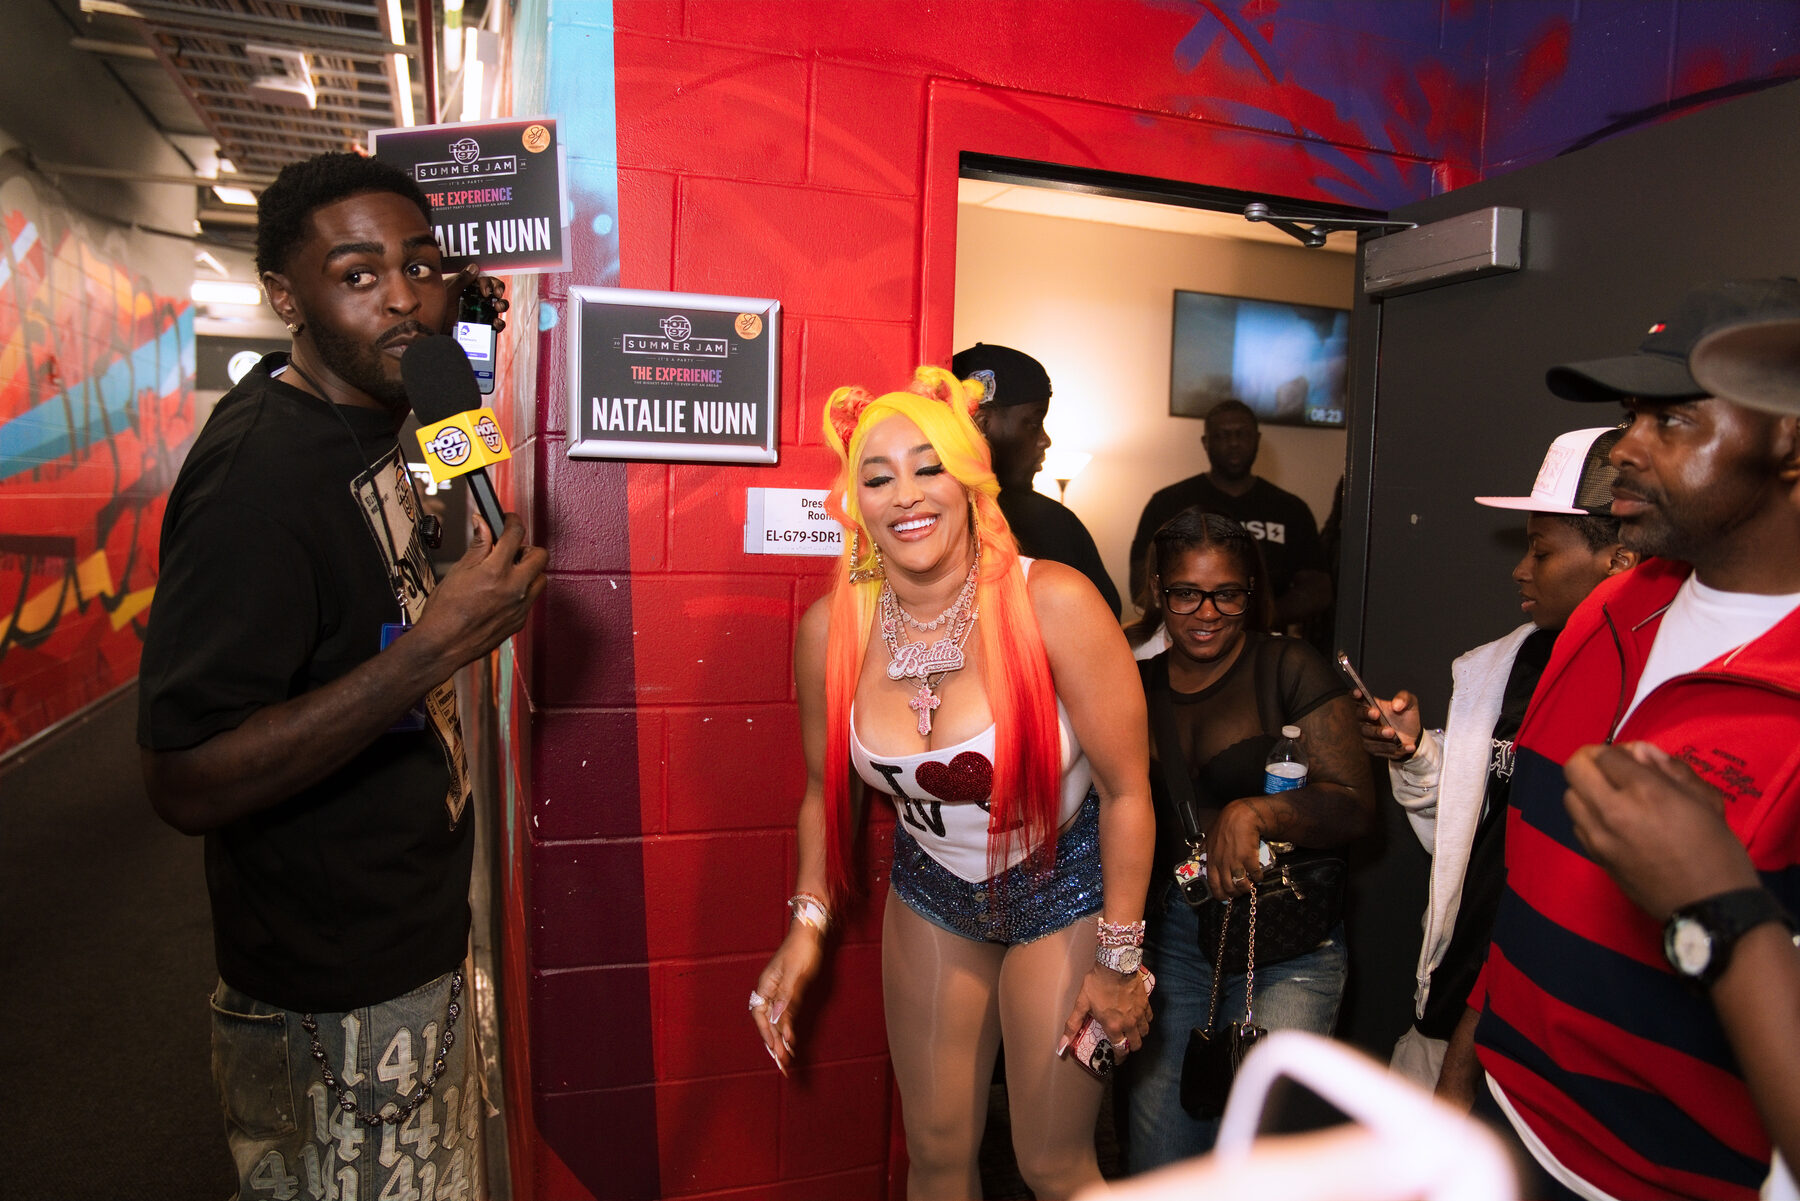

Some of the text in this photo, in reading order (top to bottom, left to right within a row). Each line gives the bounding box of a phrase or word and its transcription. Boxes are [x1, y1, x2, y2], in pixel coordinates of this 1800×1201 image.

[420, 161, 512, 177] SUMMER JAM
[424, 187, 513, 207] THE EXPERIENCE
[430, 217, 551, 258] ALIE NUNN
[628, 340, 723, 353] SUMMER JAM
[631, 366, 723, 384] THE EXPERIENCE
[592, 396, 757, 435] NATALIE NUNN
[486, 433, 501, 447] 97
[442, 442, 466, 460] 97
[801, 498, 824, 508] Dres
[766, 529, 842, 543] EL-G79-SDR1
[888, 640, 962, 678] Baddie
